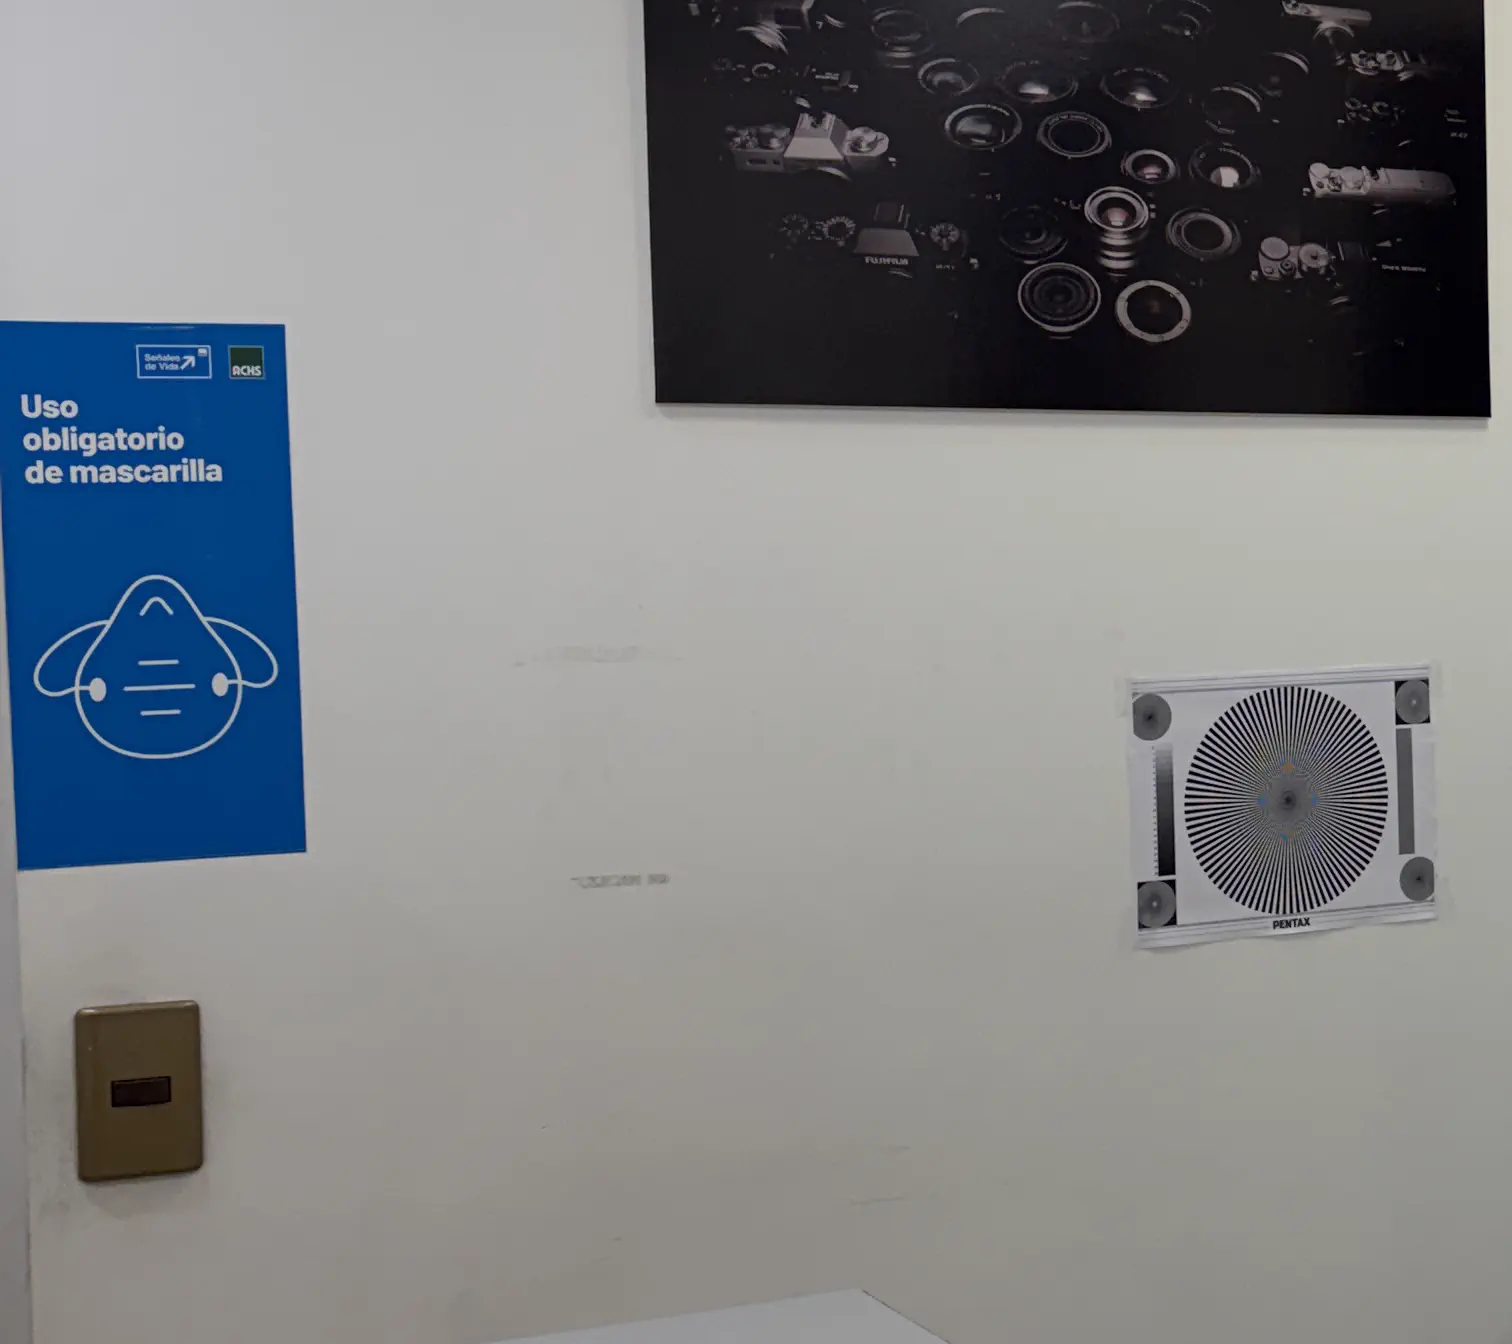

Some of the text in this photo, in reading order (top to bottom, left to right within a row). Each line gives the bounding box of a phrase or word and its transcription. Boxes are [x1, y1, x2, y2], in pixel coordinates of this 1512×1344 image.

[145, 362, 157, 370] de
[232, 365, 262, 376] ACHS
[20, 394, 79, 419] Uso
[22, 425, 185, 457] obligatorio
[24, 458, 223, 484] de mascarilla
[1272, 917, 1311, 930] PENTAX
